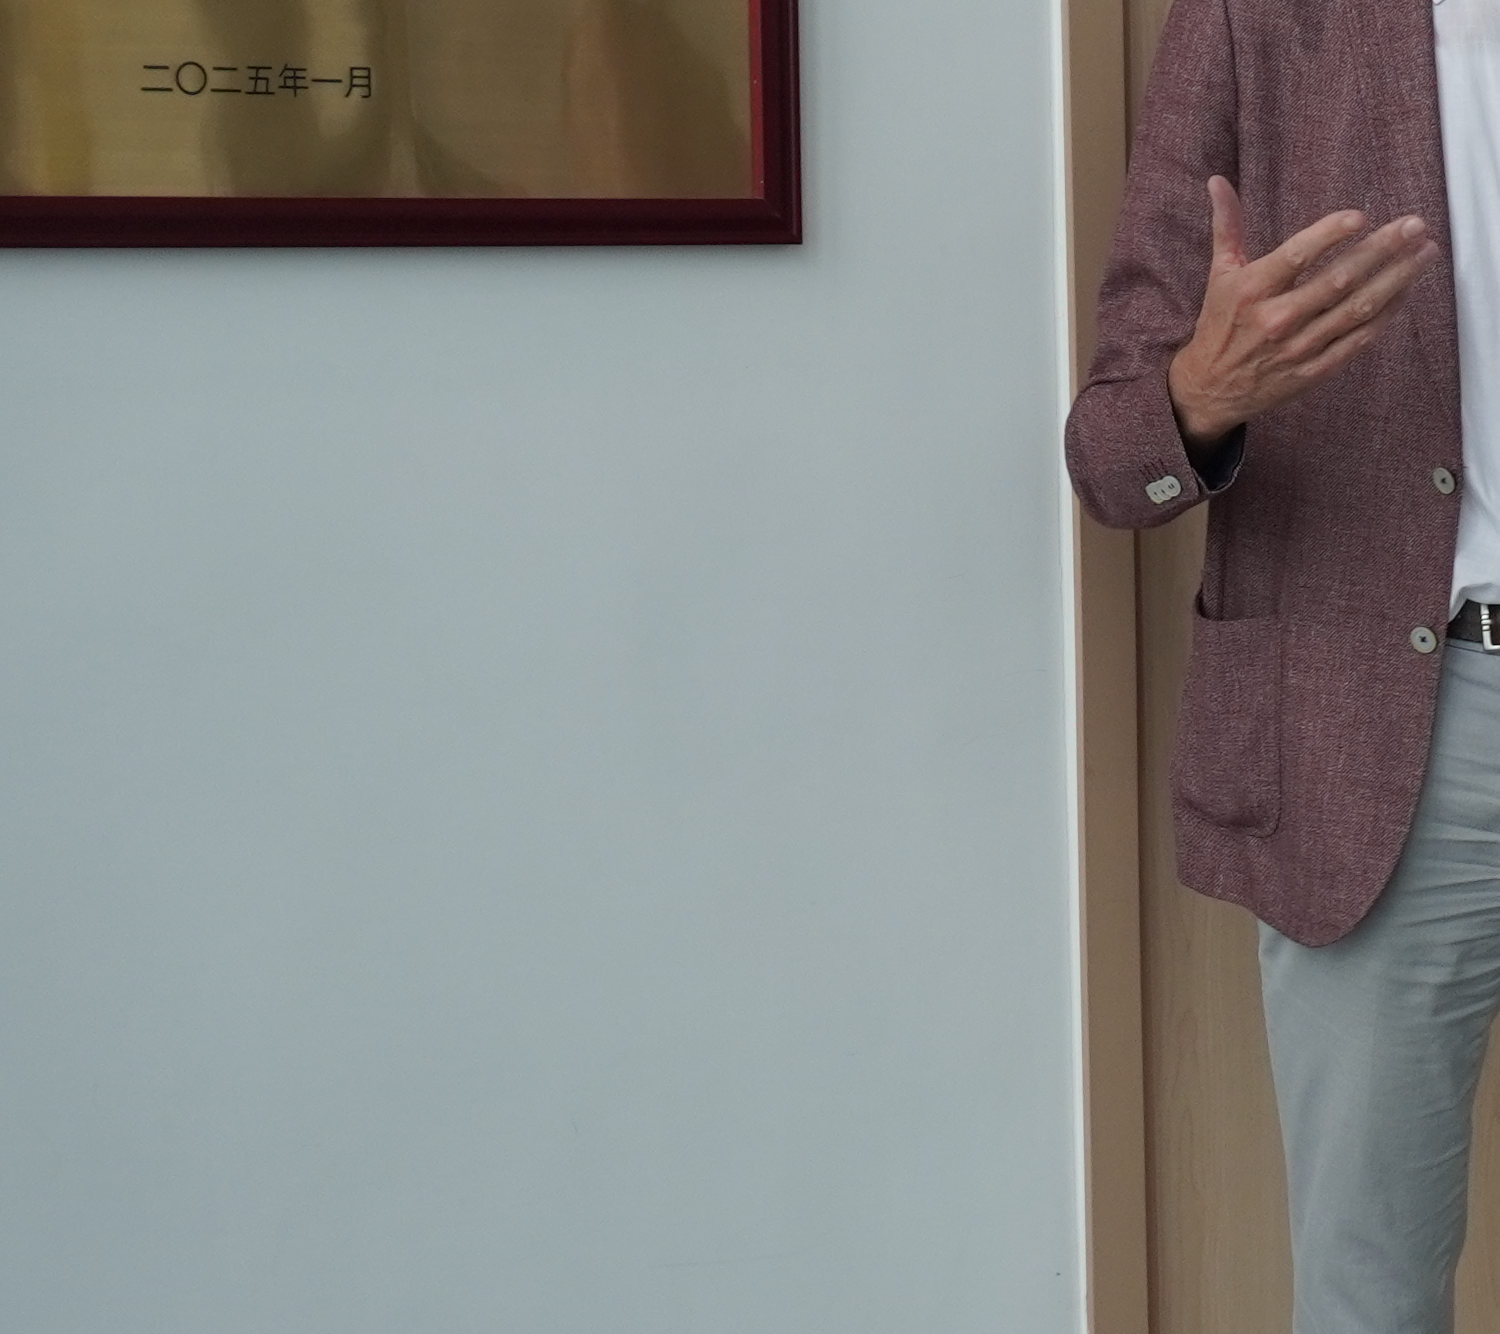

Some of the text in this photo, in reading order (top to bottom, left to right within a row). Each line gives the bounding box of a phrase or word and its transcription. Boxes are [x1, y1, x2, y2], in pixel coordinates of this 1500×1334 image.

[141, 61, 372, 98] 二〇二五年一月
